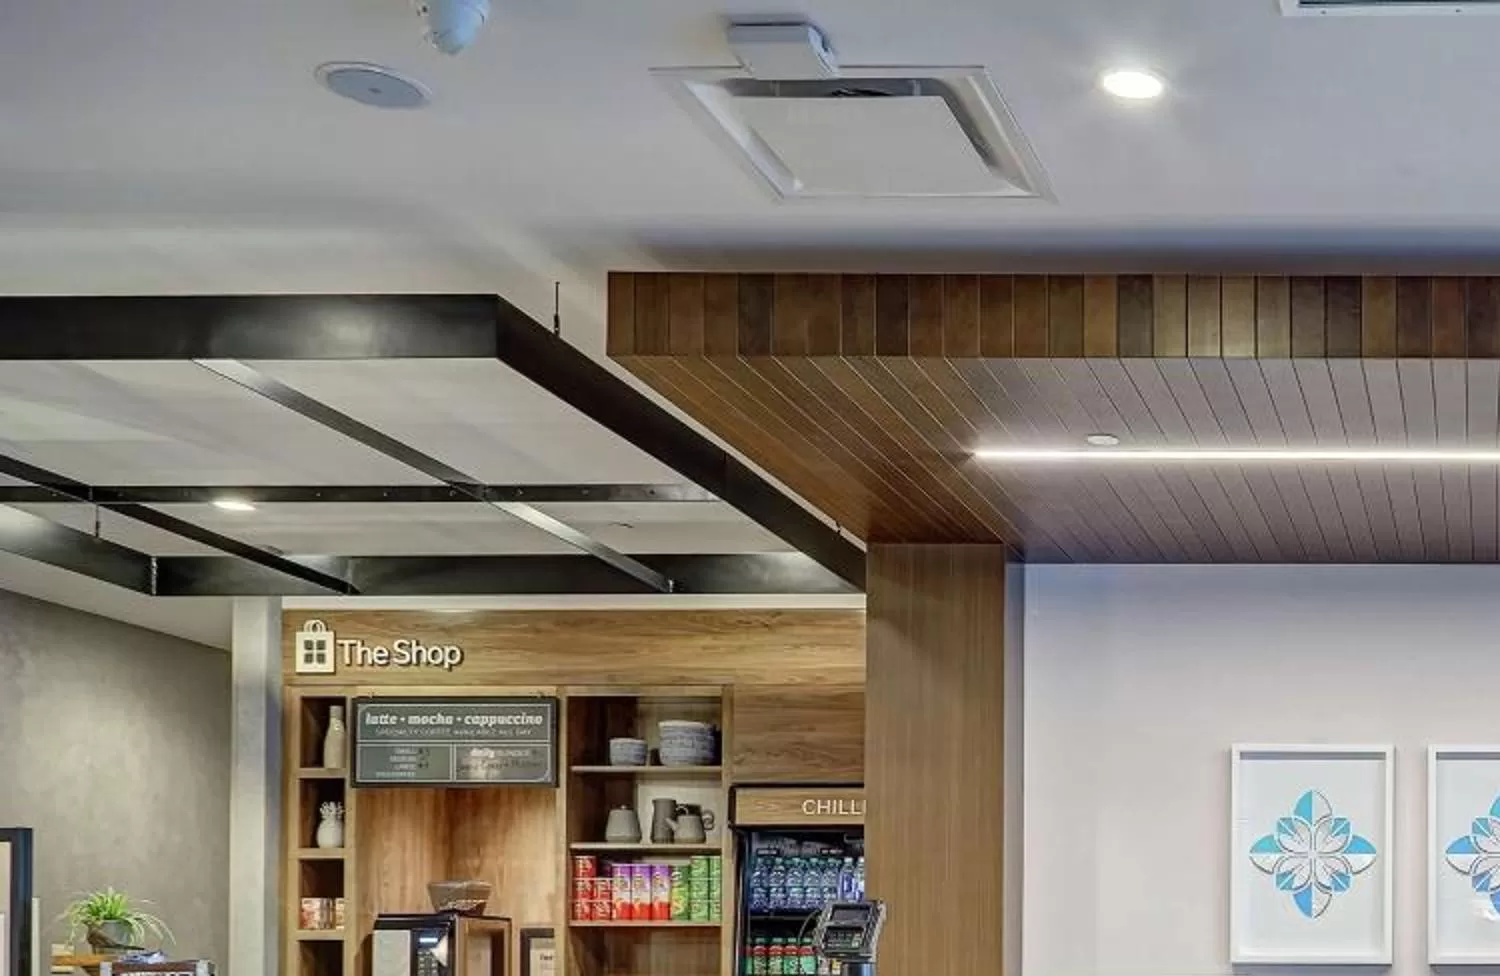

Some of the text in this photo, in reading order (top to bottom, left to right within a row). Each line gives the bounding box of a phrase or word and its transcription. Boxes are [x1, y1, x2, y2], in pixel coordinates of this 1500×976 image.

[336, 638, 462, 669] The Shop
[365, 712, 543, 727] latte mocha cappuccino
[802, 799, 867, 815] CHILL
